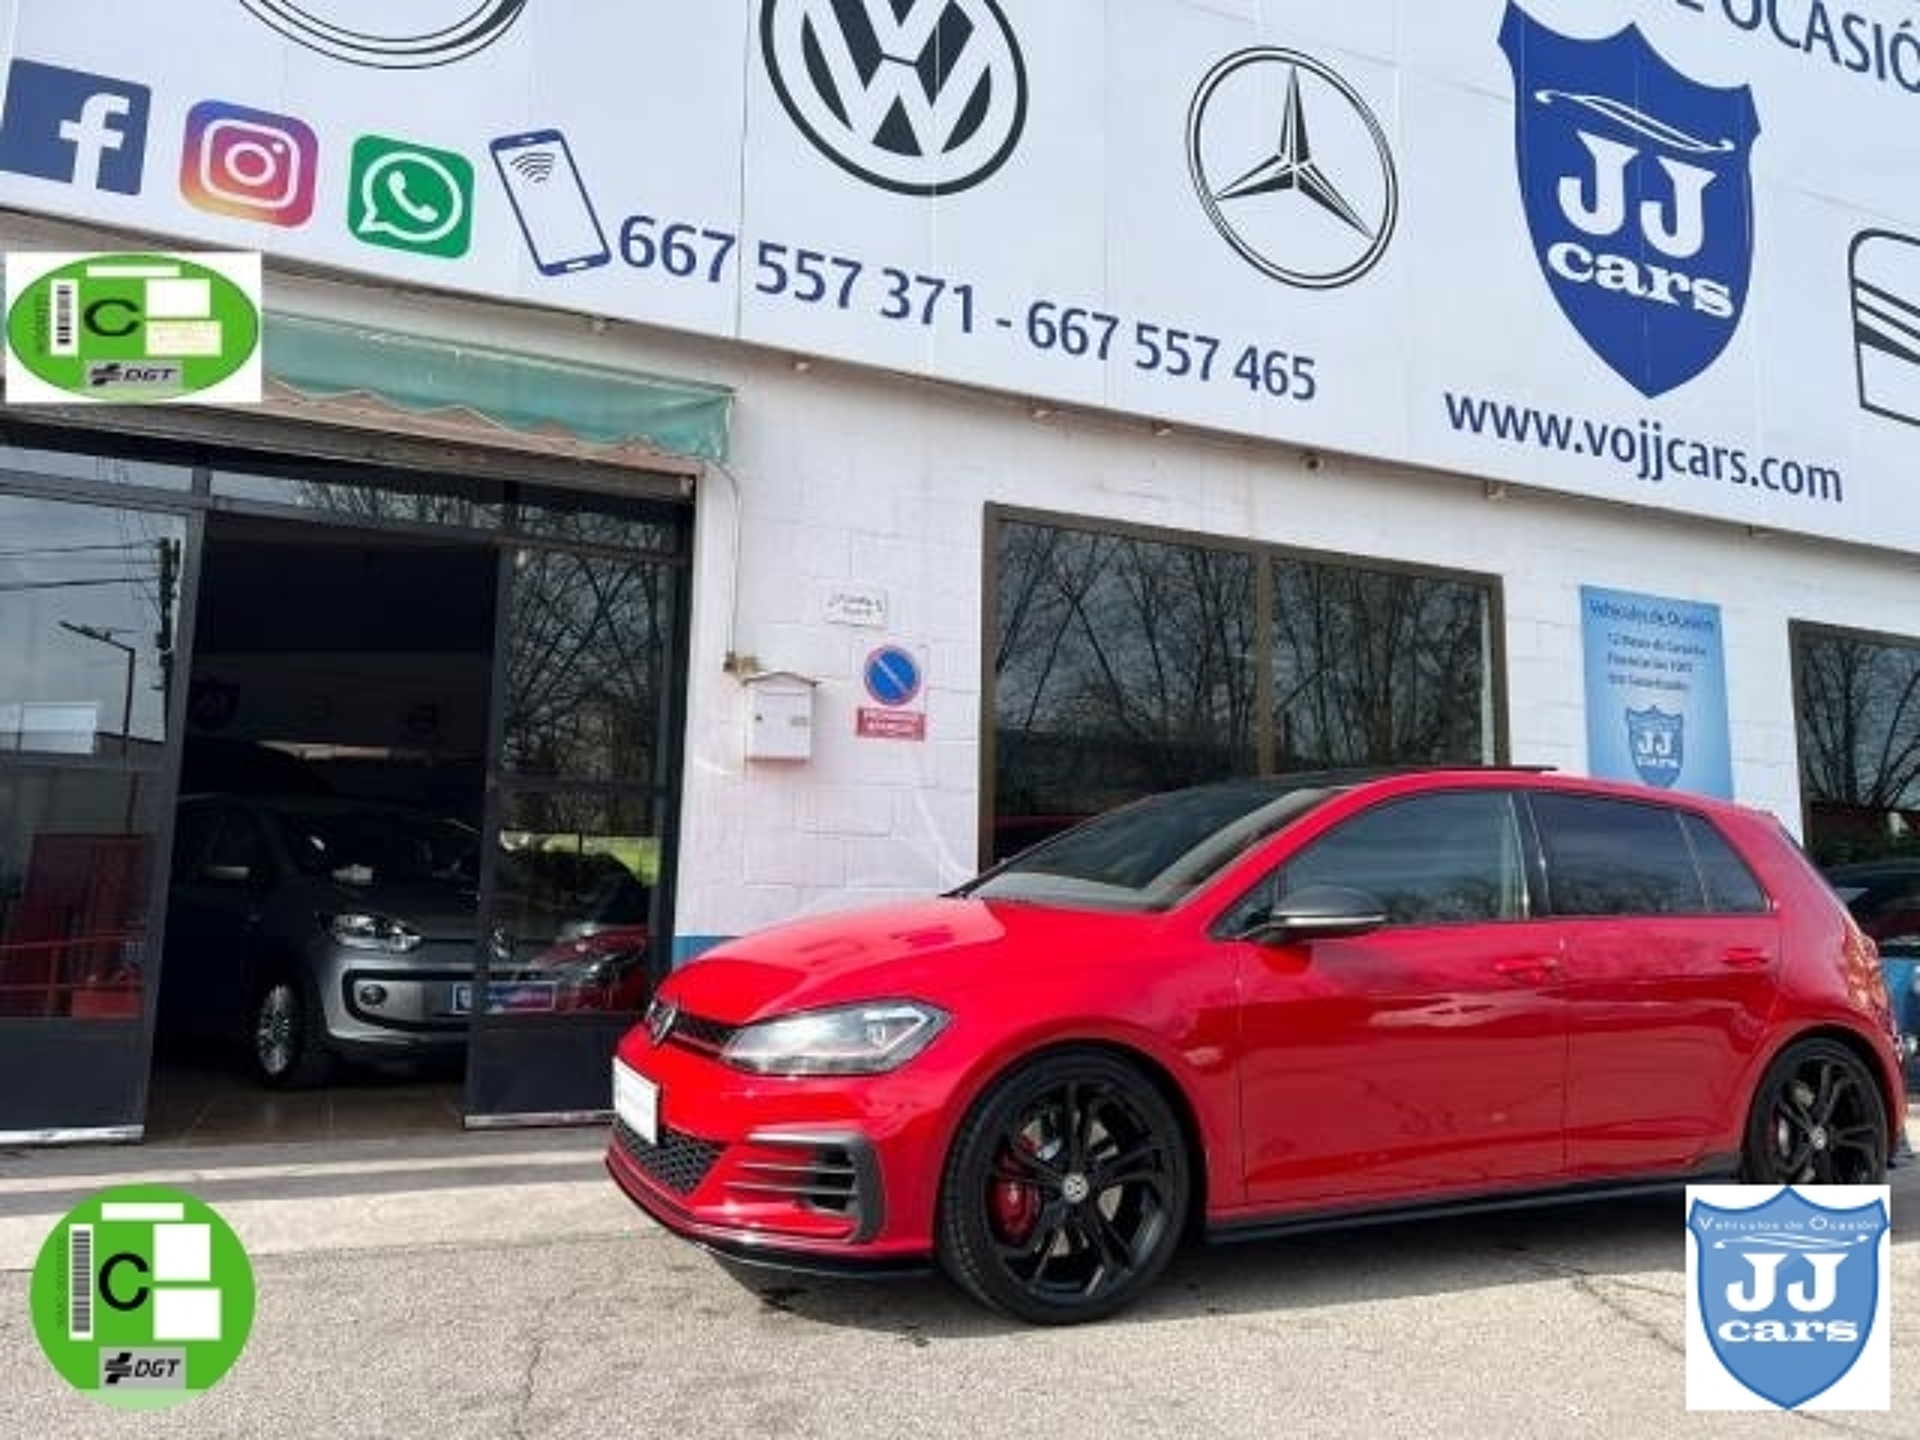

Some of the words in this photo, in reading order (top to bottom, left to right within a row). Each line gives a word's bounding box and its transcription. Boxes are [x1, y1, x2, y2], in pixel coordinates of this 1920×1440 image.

[1558, 129, 1716, 258] JJ
[619, 214, 737, 283] 667
[755, 241, 862, 310] 557
[880, 267, 974, 334] 371
[1026, 301, 1120, 361] 667
[1134, 323, 1220, 381] 557
[1234, 346, 1317, 401] 465
[1547, 242, 1734, 319] cars
[1444, 392, 1843, 501] www.vojjcars.com
